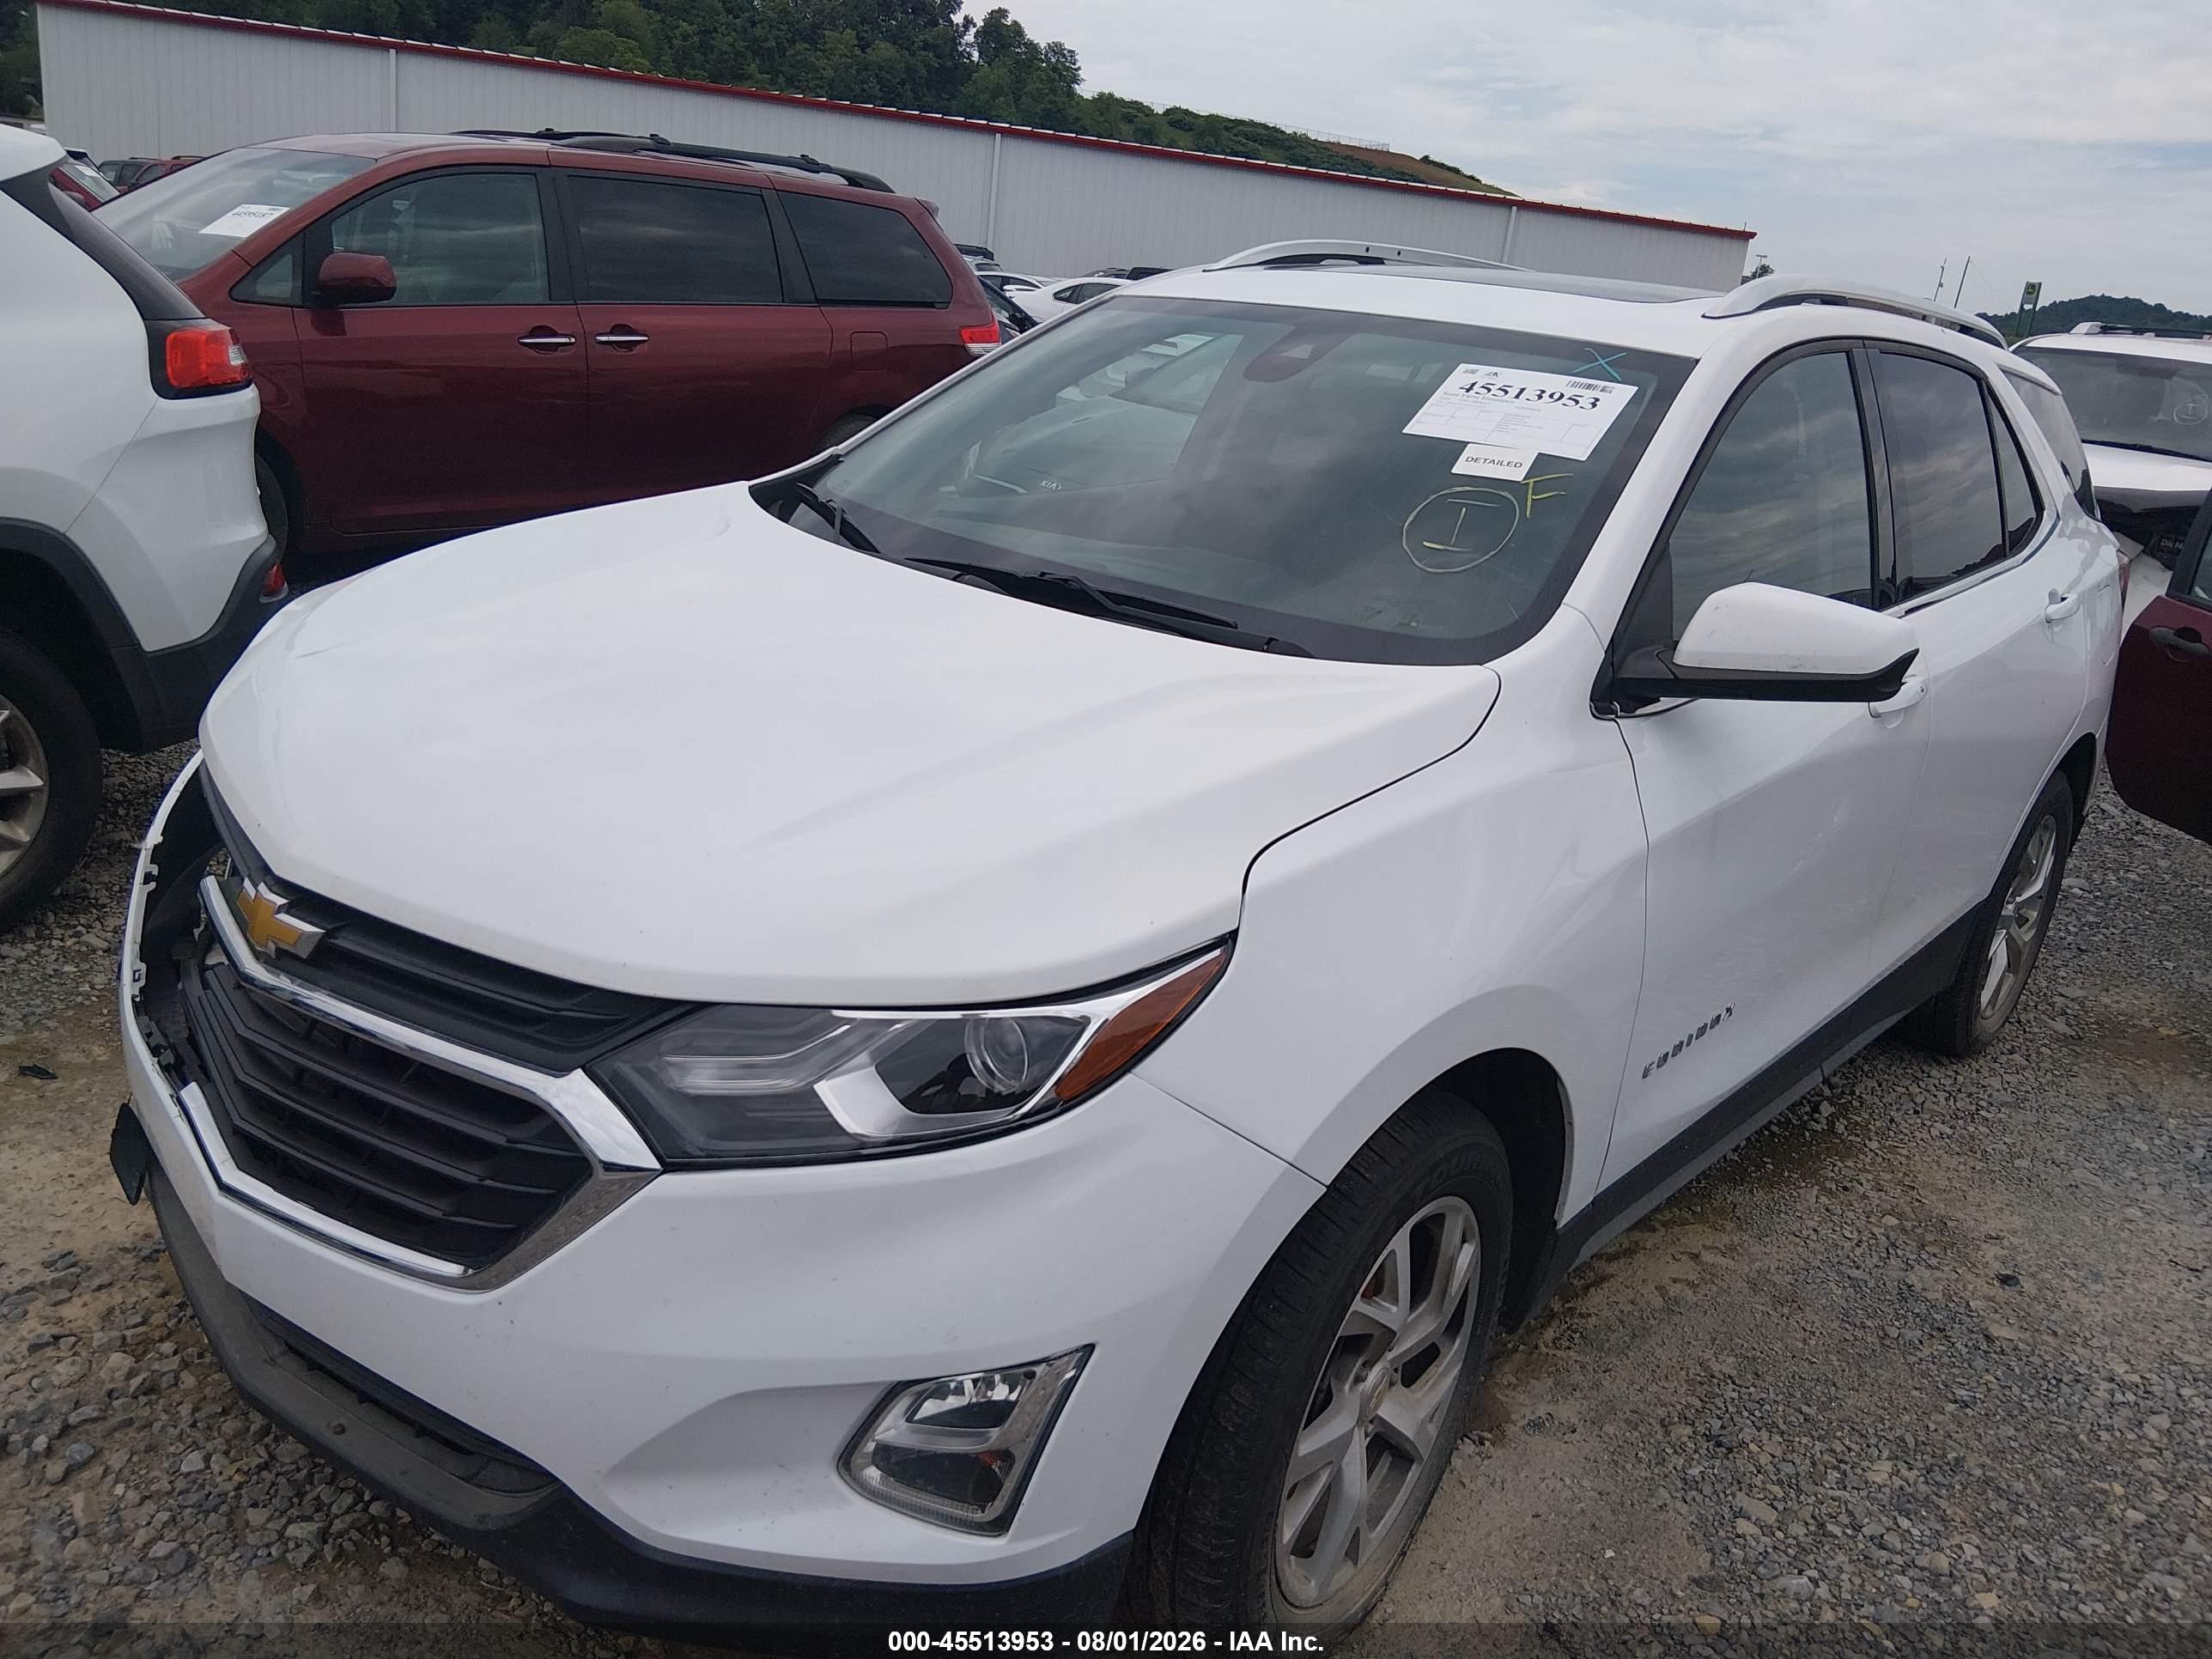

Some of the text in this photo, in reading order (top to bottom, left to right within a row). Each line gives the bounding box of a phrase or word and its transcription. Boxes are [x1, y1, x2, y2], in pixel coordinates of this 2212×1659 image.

[1458, 380, 1601, 410] 45513953
[1465, 456, 1523, 468] DETAILED
[1039, 480, 1060, 490] KIA
